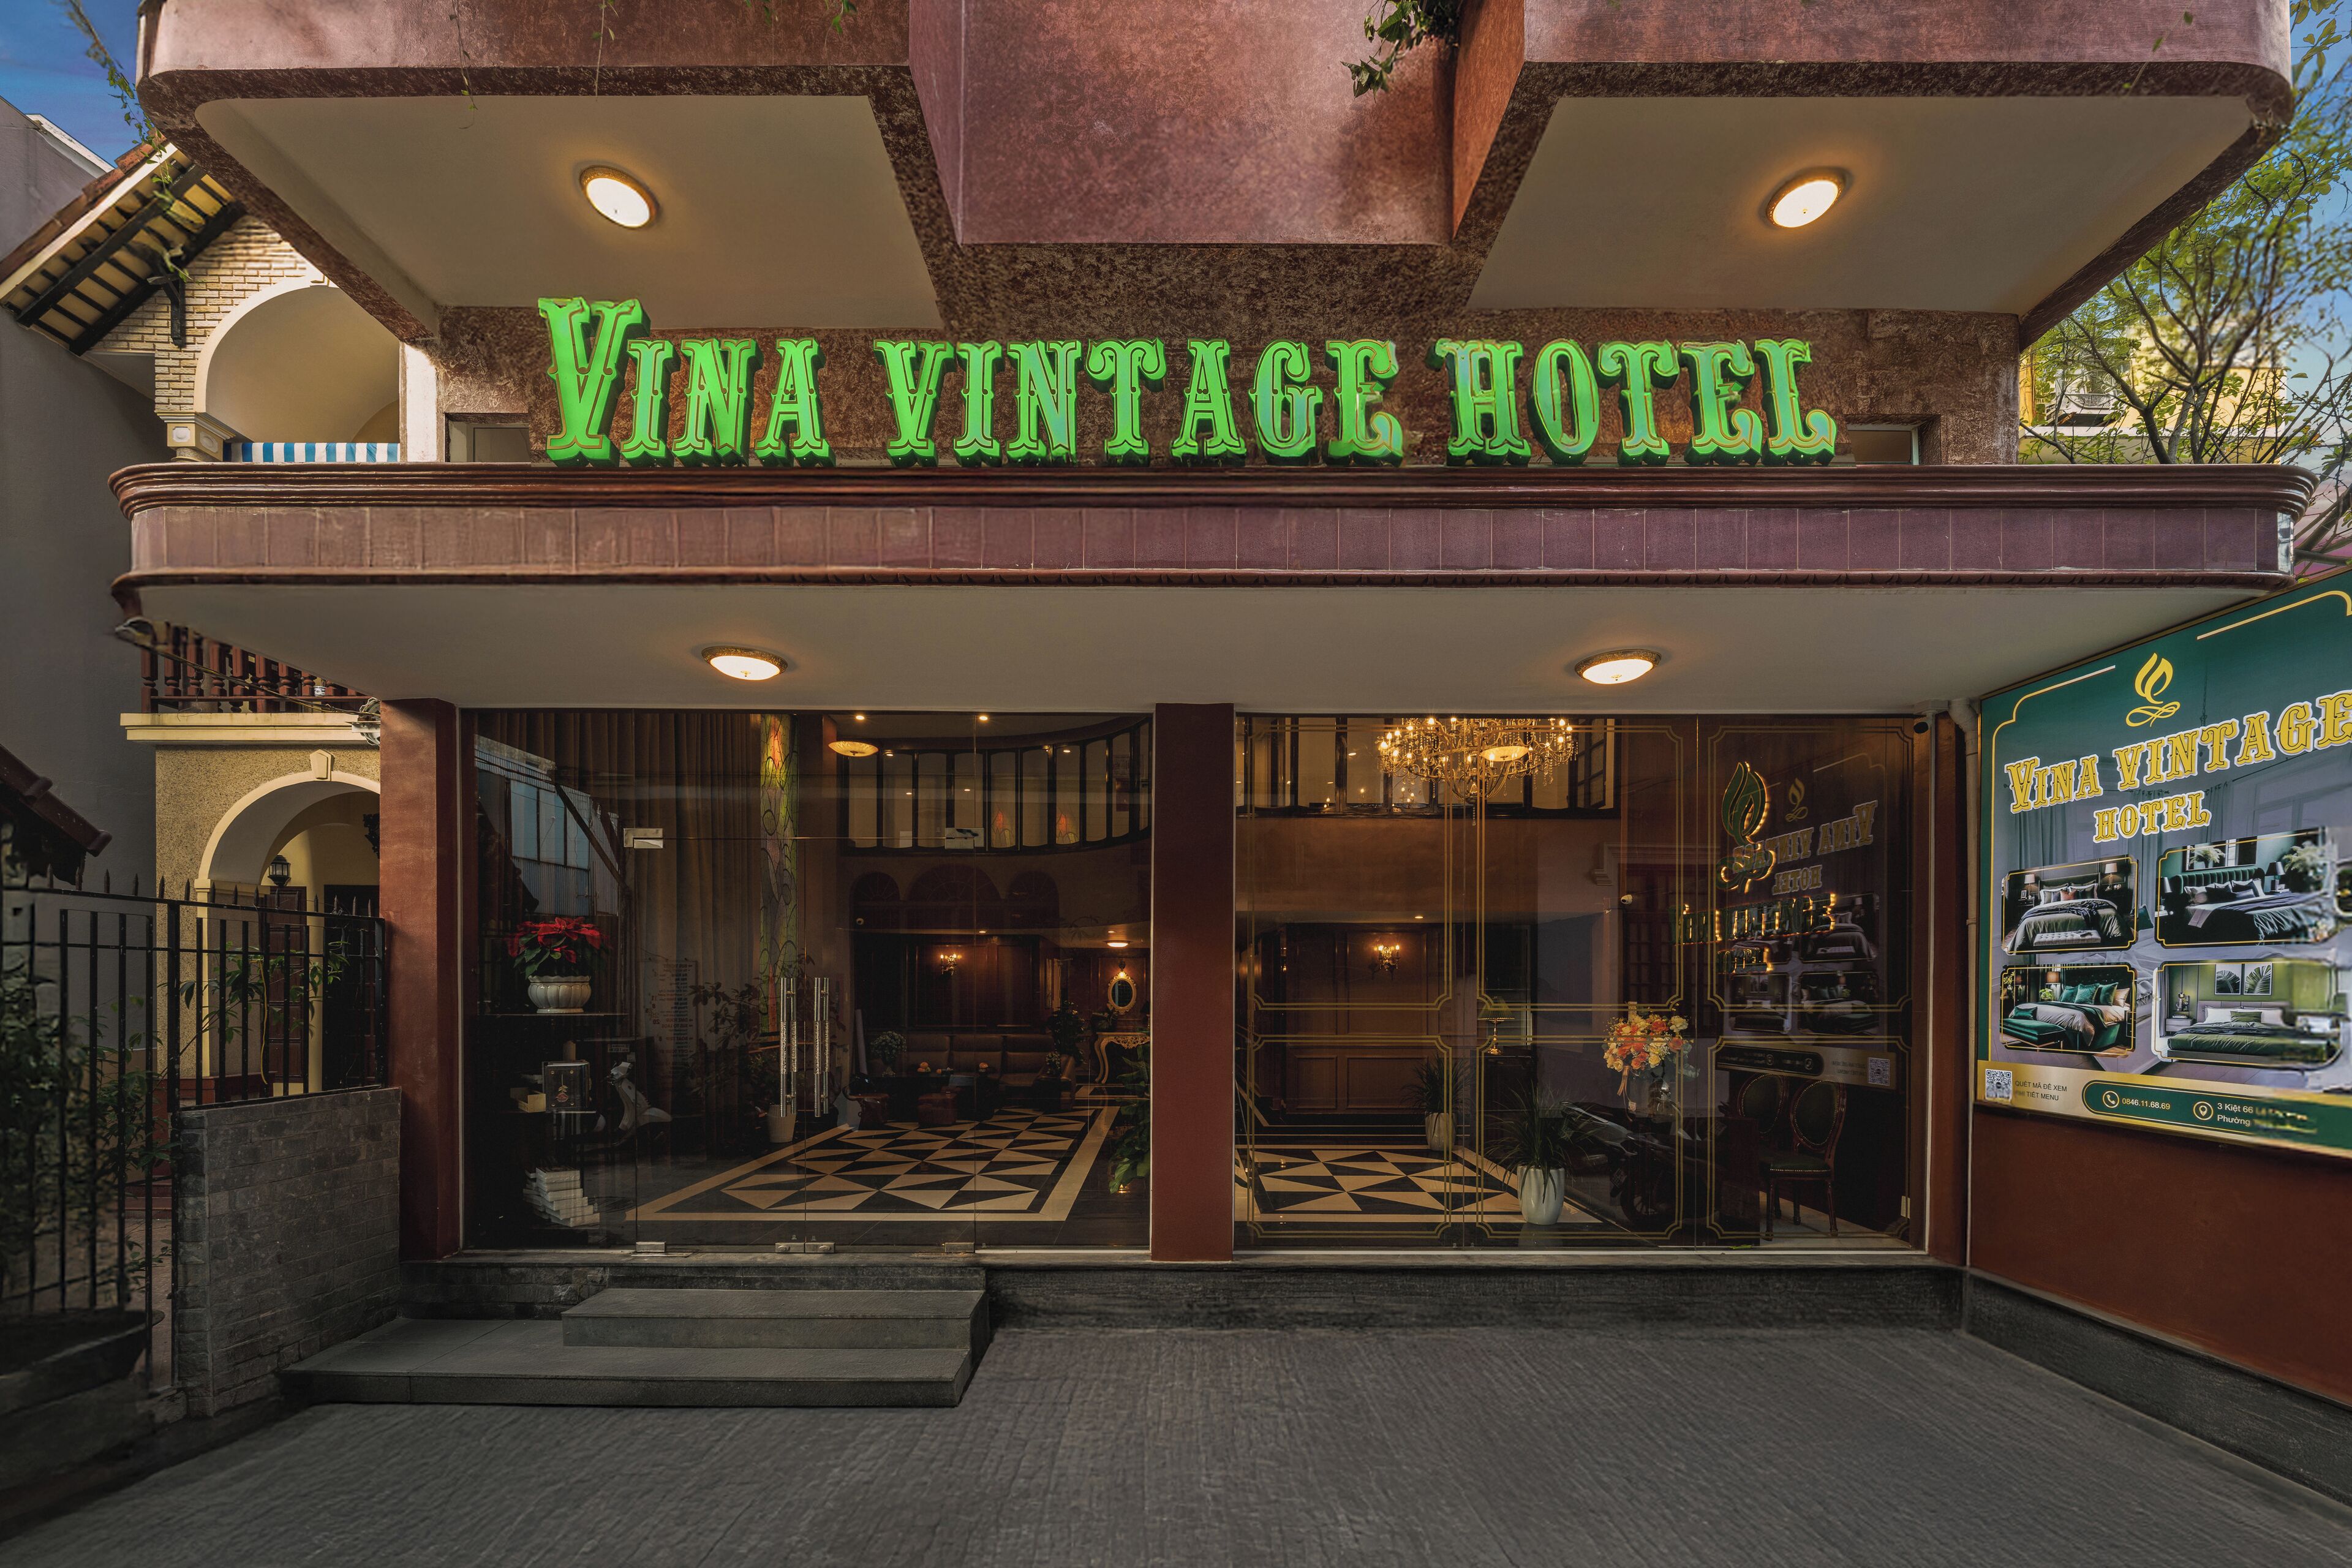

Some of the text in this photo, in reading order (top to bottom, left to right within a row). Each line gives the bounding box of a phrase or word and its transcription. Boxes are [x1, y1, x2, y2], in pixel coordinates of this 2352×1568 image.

[537, 296, 1836, 467] VINA VINTAGE HOTEL
[2004, 689, 2352, 814] VINA VINTAGE
[2093, 791, 2212, 843] HOTEL
[2122, 1098, 2170, 1110] 0846.11.68.69
[2225, 1103, 2241, 1113] Kiệt
[2217, 1114, 2250, 1127] Phường
